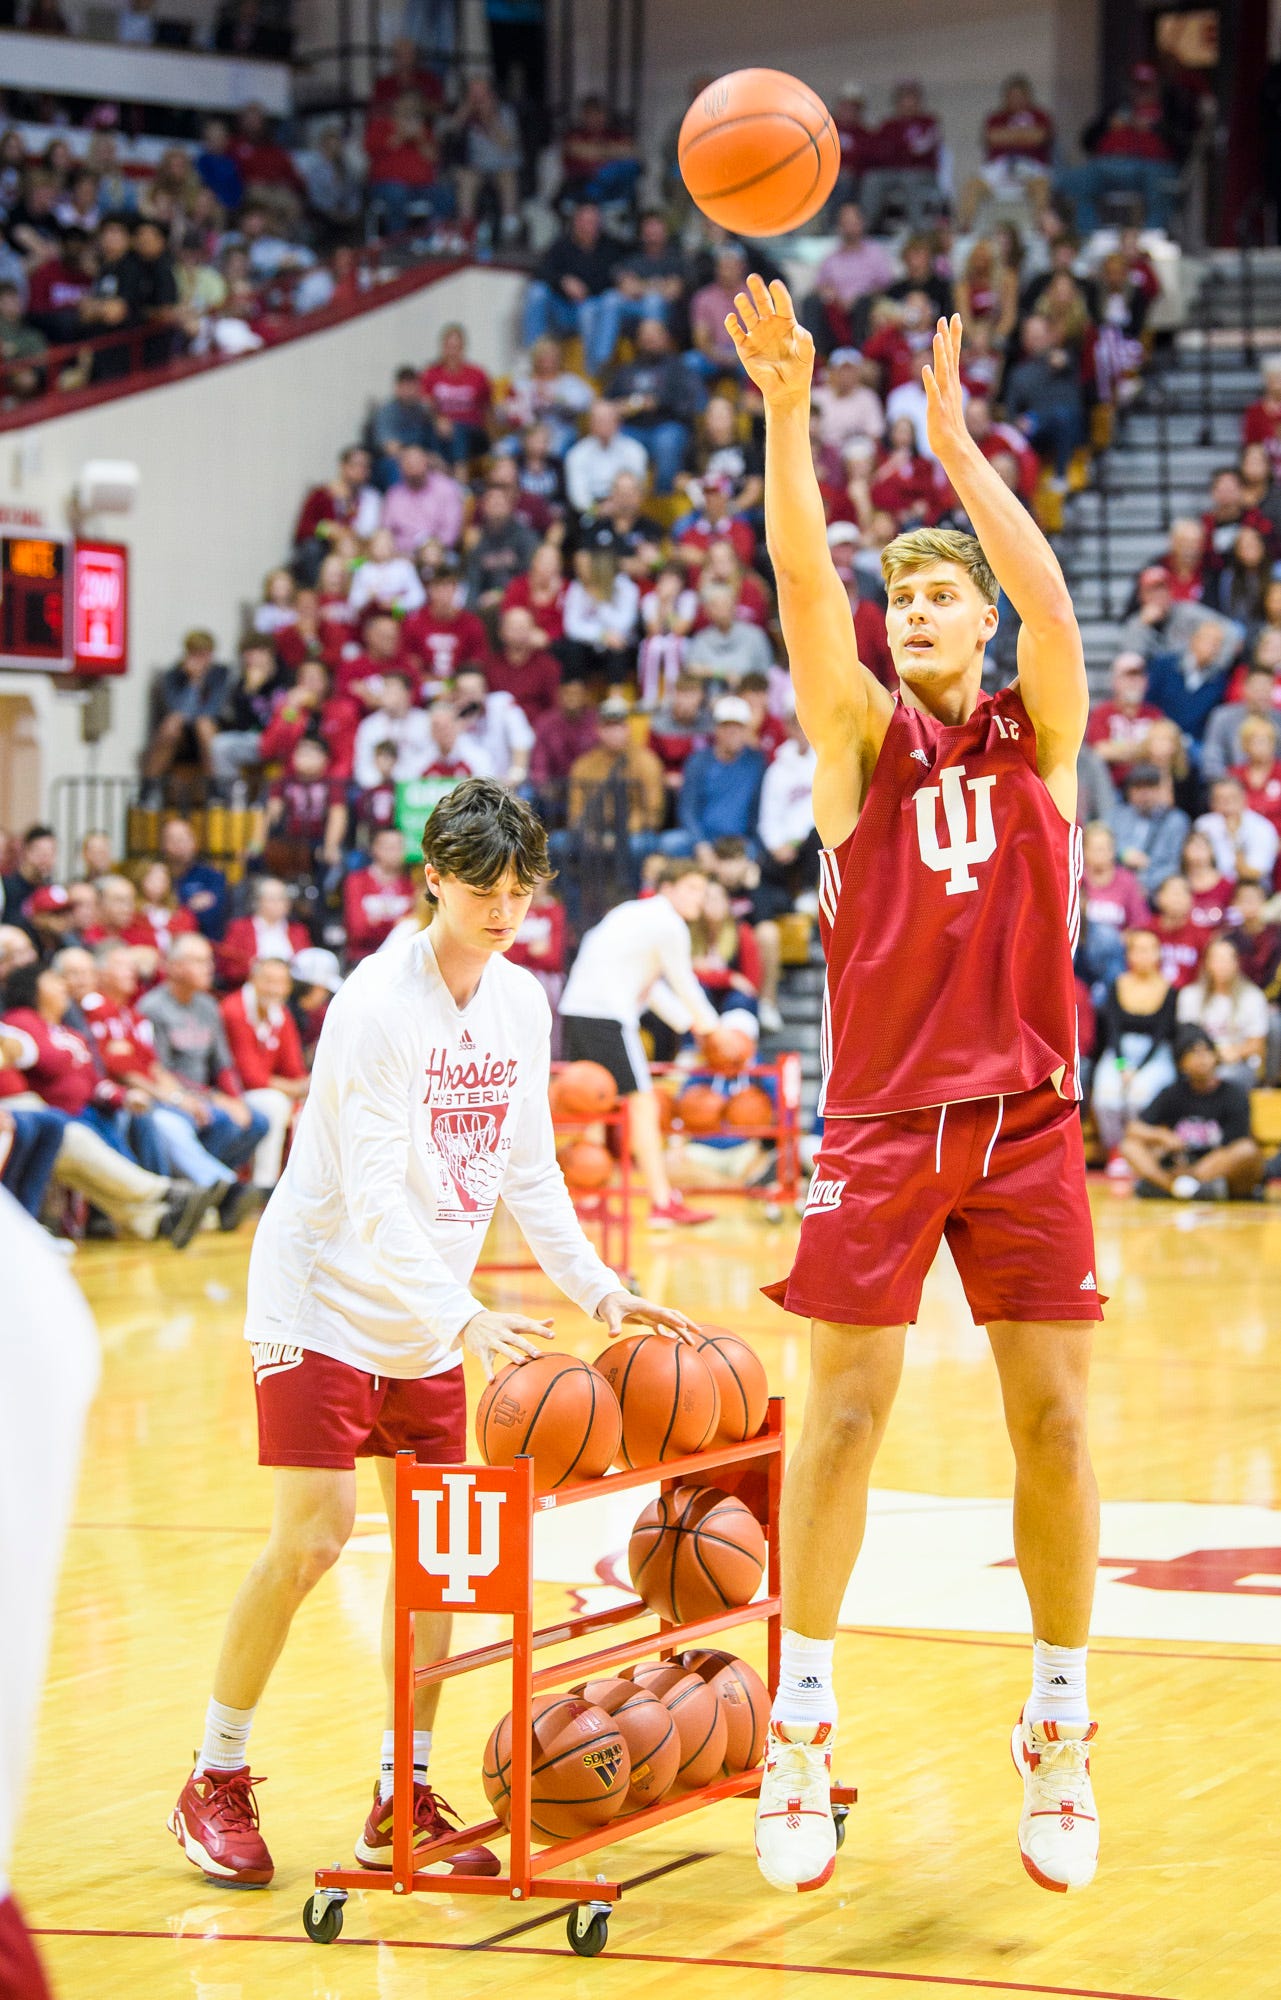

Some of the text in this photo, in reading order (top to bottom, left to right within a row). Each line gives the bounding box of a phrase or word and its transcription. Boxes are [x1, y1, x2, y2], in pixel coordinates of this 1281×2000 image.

[911, 764, 998, 896] IU
[423, 1047, 518, 1105] Hoosier
[431, 1089, 510, 1106] HYSTERIA
[501, 1137, 512, 1150] 22
[411, 1473, 507, 1603] IU
